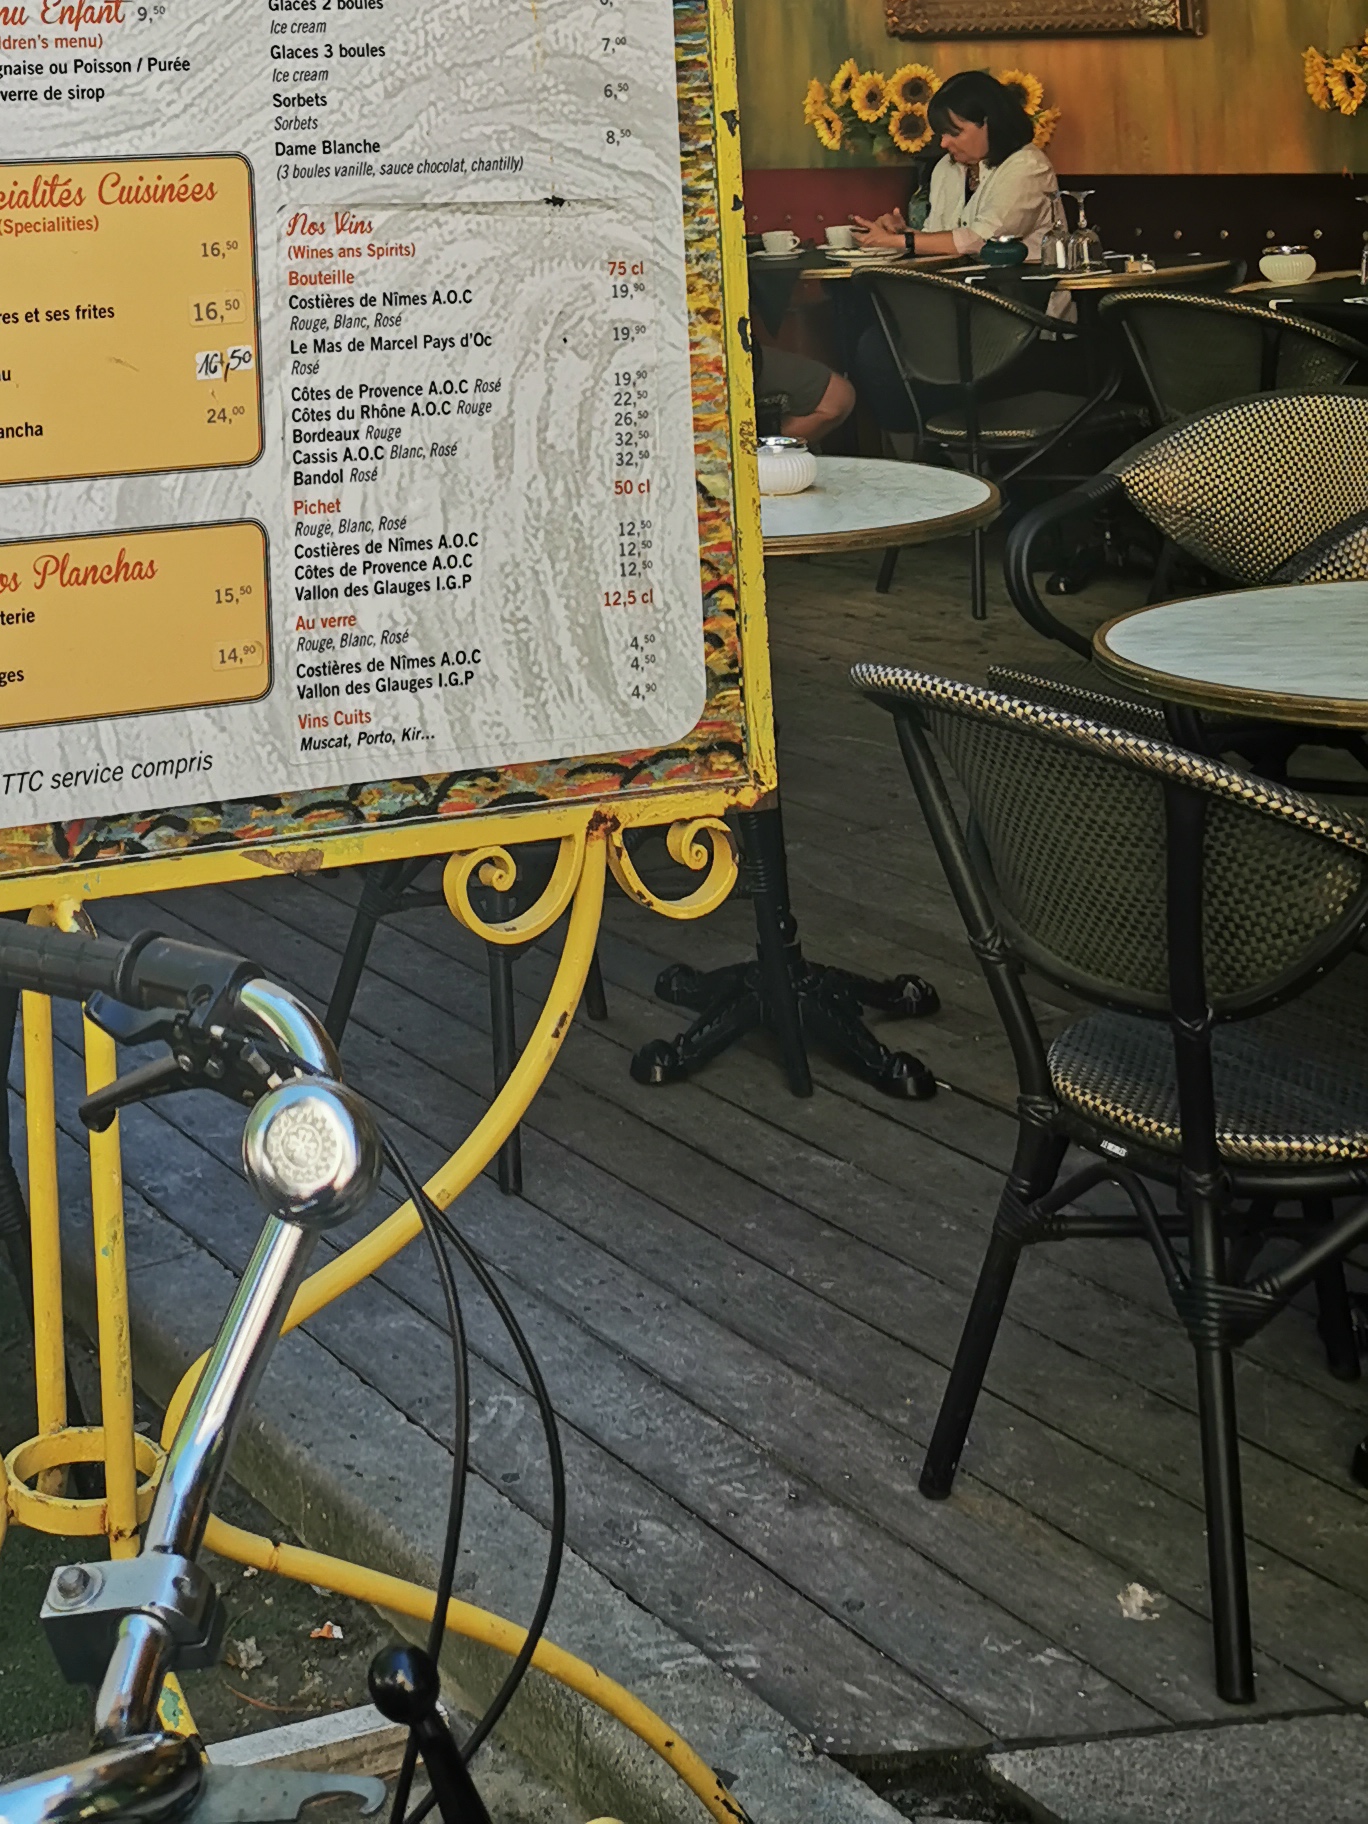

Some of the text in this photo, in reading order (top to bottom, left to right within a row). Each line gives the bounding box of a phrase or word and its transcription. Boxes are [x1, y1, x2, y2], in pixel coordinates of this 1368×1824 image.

[53, 32, 103, 49] menu)
[269, 41, 386, 60] Glaces 3 boules
[272, 114, 319, 131] Sorbets
[273, 137, 381, 157] Dame Blanche
[96, 171, 218, 206] Cuisinées
[285, 210, 374, 237] Nos Vins
[287, 268, 355, 287] Bouteille
[606, 259, 644, 277] 75 cl
[287, 287, 473, 310] Costières de Nîmes A.O.C
[292, 496, 341, 517] Pichet
[32, 546, 156, 590] Planchas
[603, 586, 654, 608] 12,5 cl
[296, 708, 372, 730] Vins Cuits
[299, 732, 352, 752] Muscat,
[356, 729, 396, 747] Porto,
[1, 768, 44, 795] TTC
[49, 761, 124, 790] service
[130, 749, 213, 780] compris
